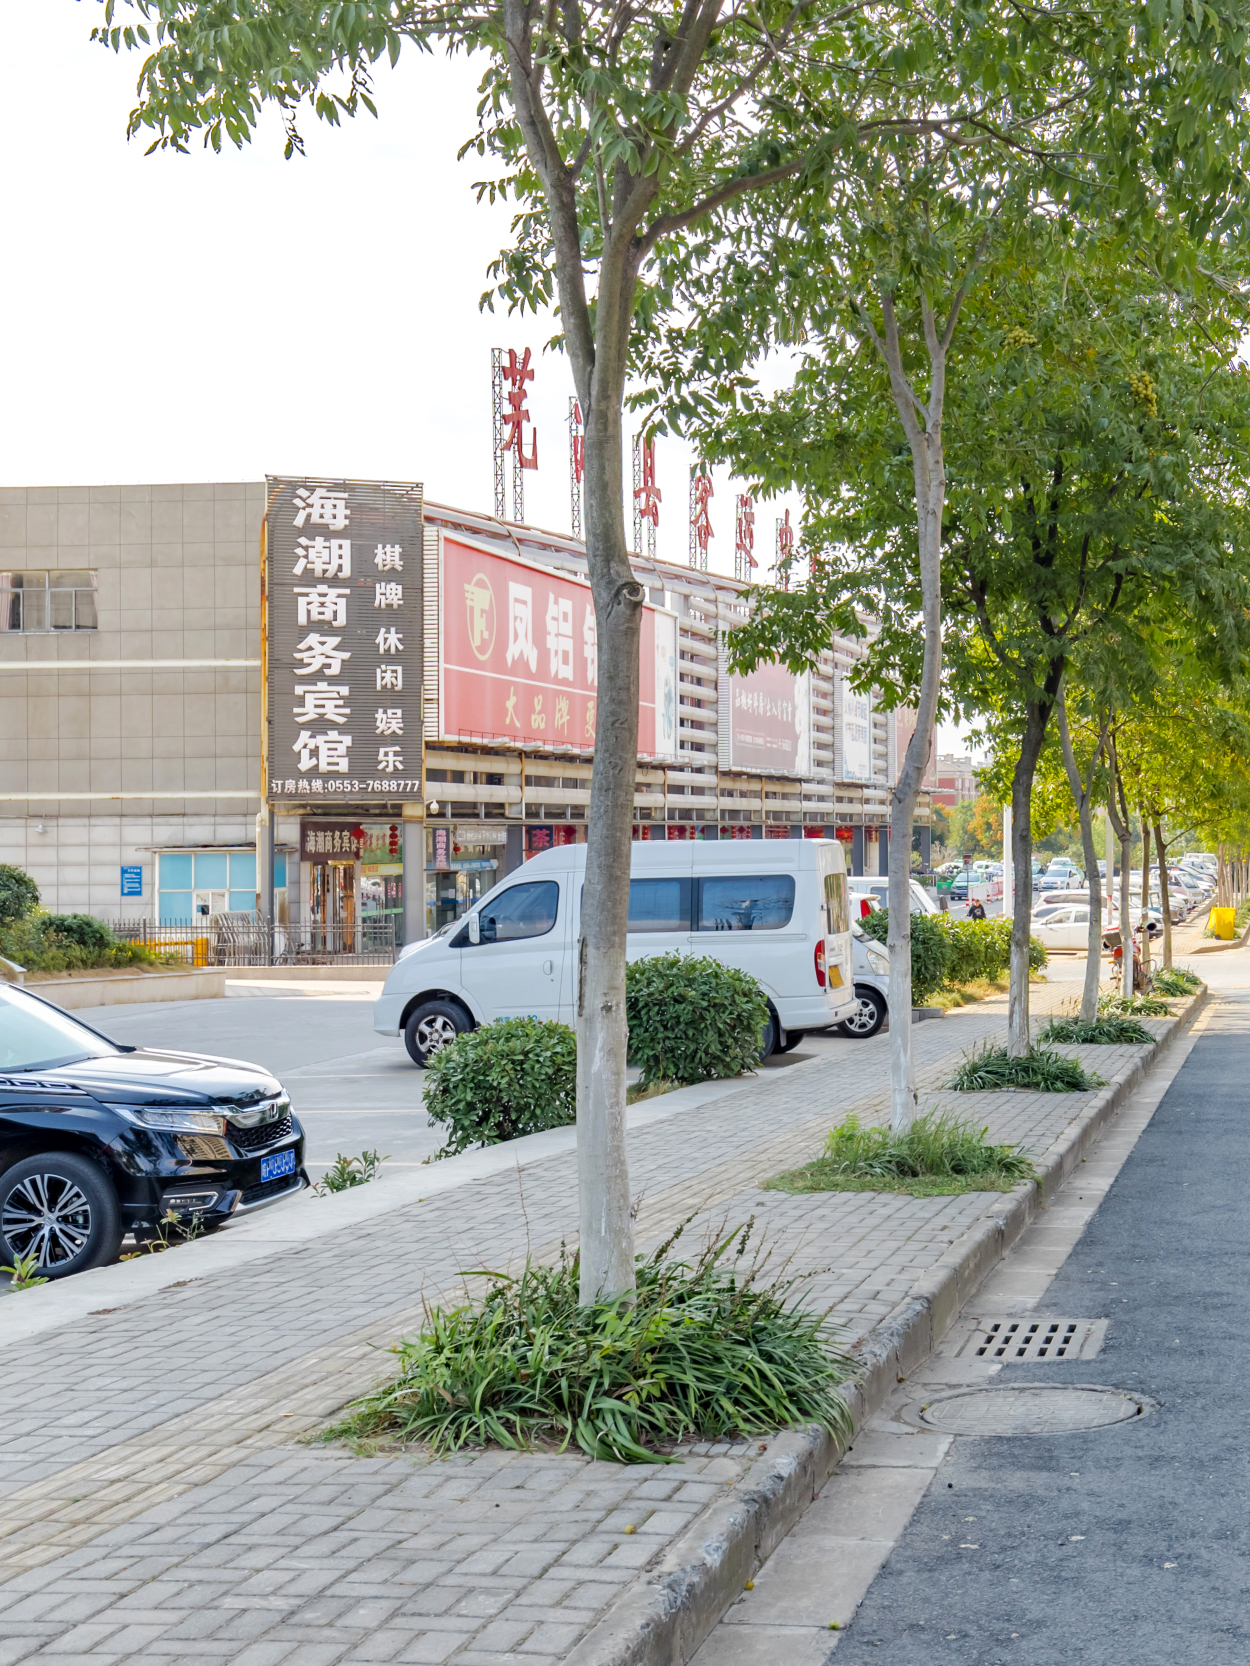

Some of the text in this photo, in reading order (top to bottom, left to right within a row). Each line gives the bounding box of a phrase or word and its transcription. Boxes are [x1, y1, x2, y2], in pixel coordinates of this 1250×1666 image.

[292, 487, 352, 774] 海潮商务宾馆
[374, 543, 405, 773] 棋牌休闲娱乐
[271, 779, 420, 794] 订房热线:0553-7688777
[532, 828, 550, 847] 茶
